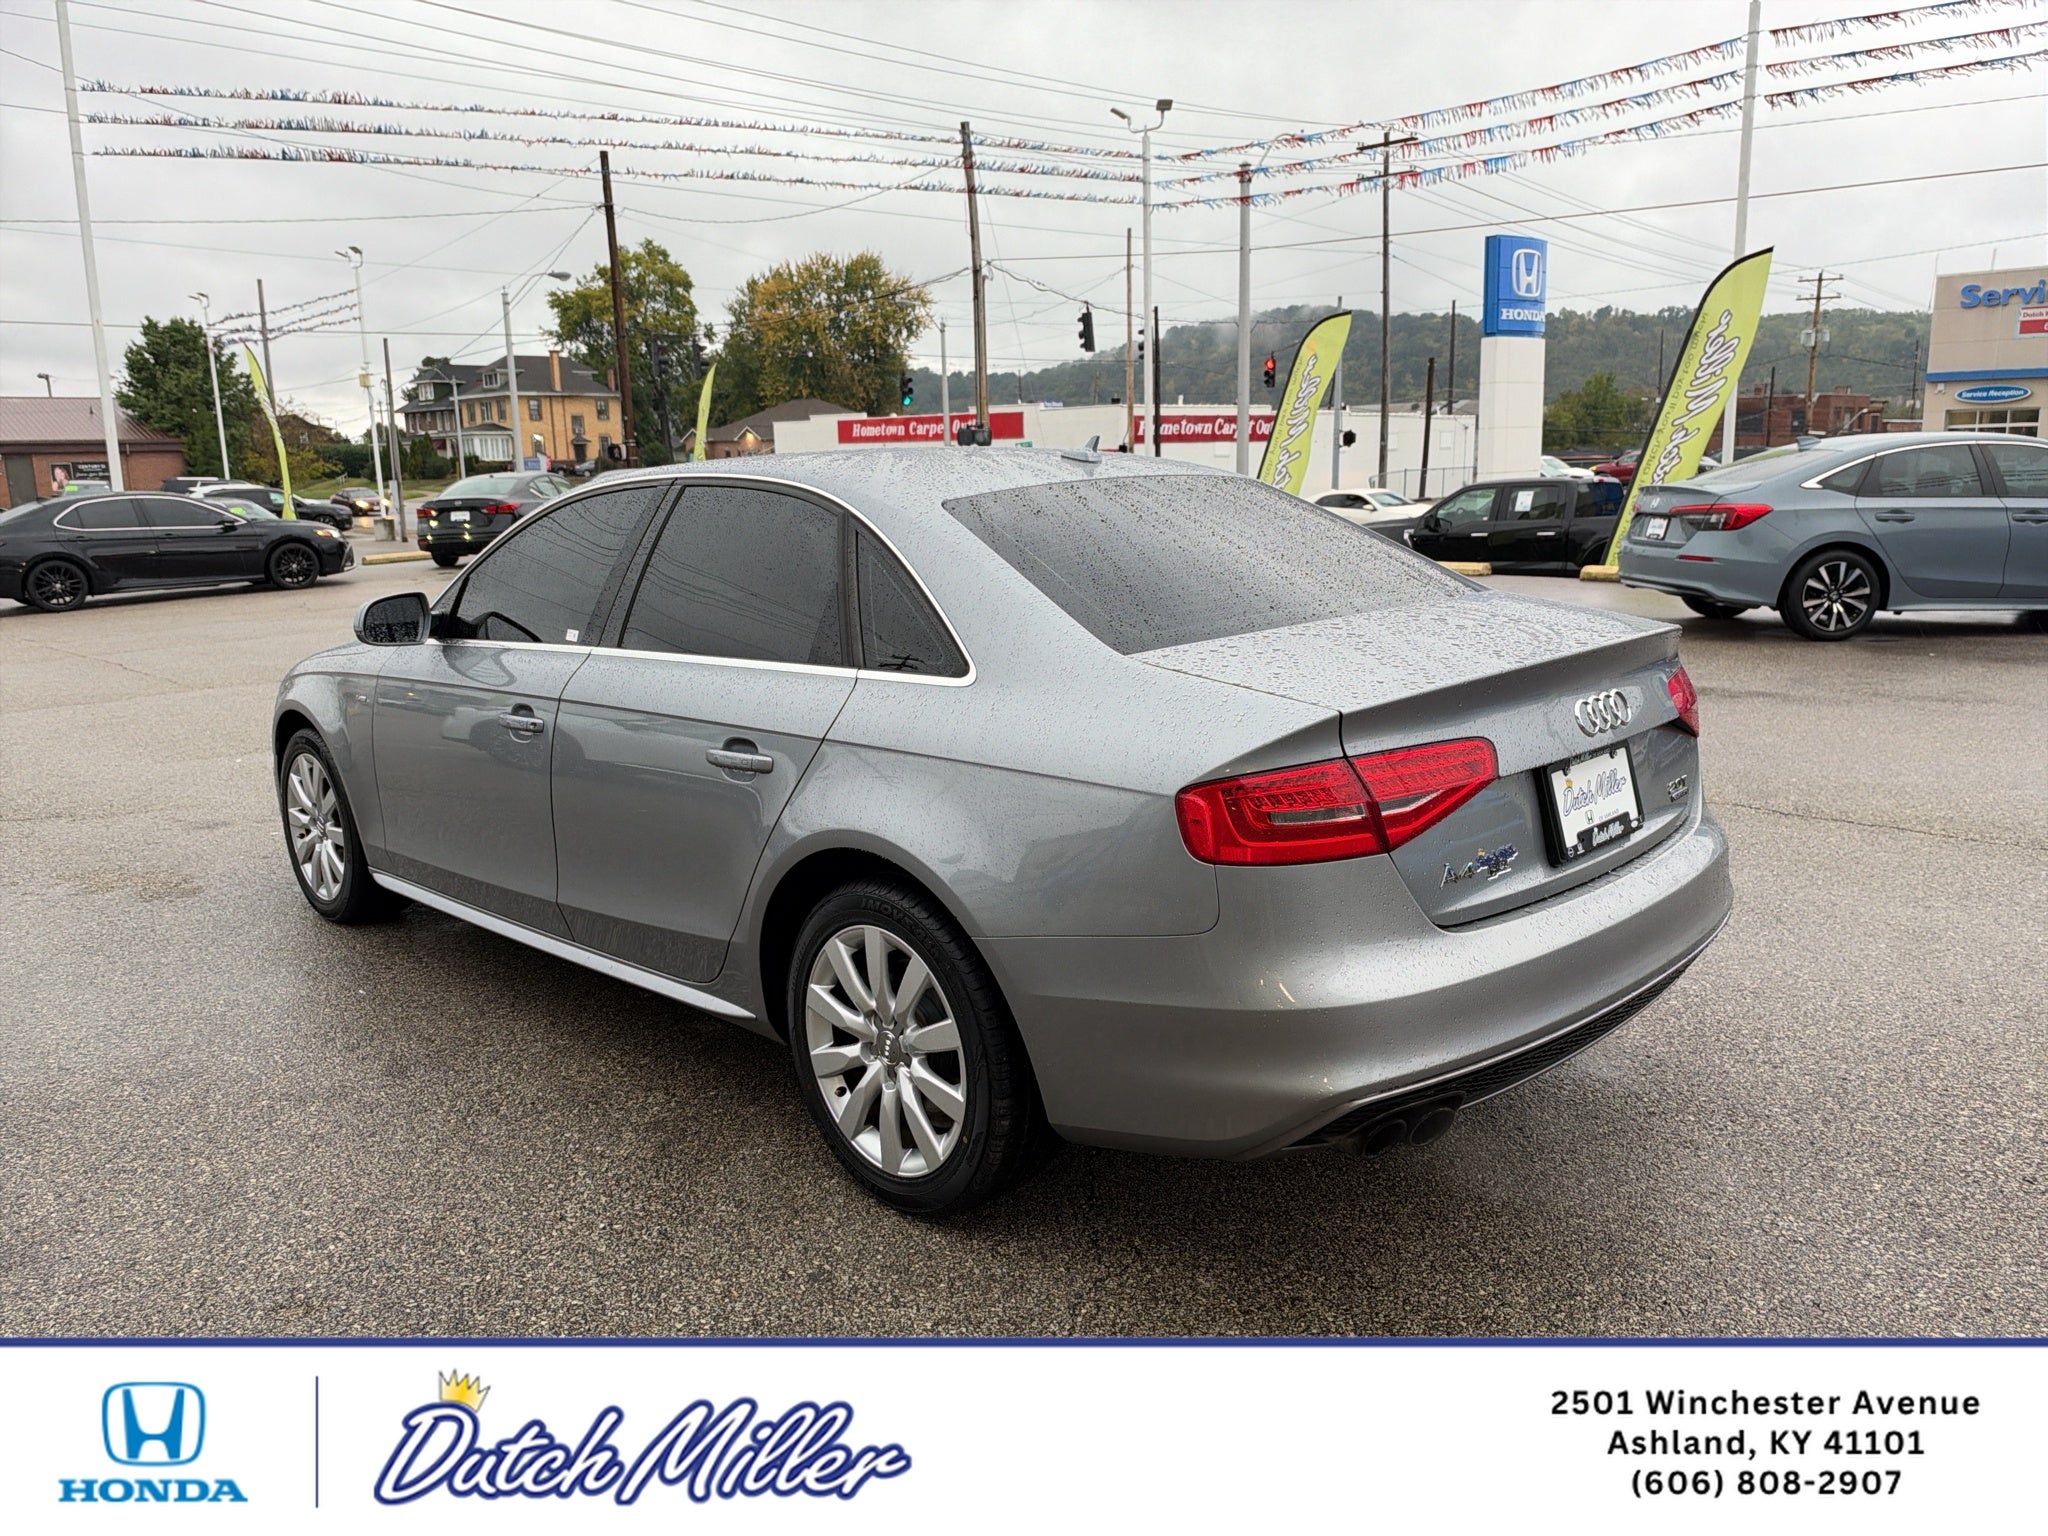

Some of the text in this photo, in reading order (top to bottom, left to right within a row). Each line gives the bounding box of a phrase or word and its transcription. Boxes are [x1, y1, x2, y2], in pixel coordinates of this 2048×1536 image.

[1960, 279, 2048, 309] Servi
[1500, 308, 1546, 322] HONDA
[852, 422, 905, 437] Hometown
[909, 418, 944, 437] Carpe
[1137, 419, 1212, 435] Hmetown
[1563, 768, 1626, 817] Dutch Miller
